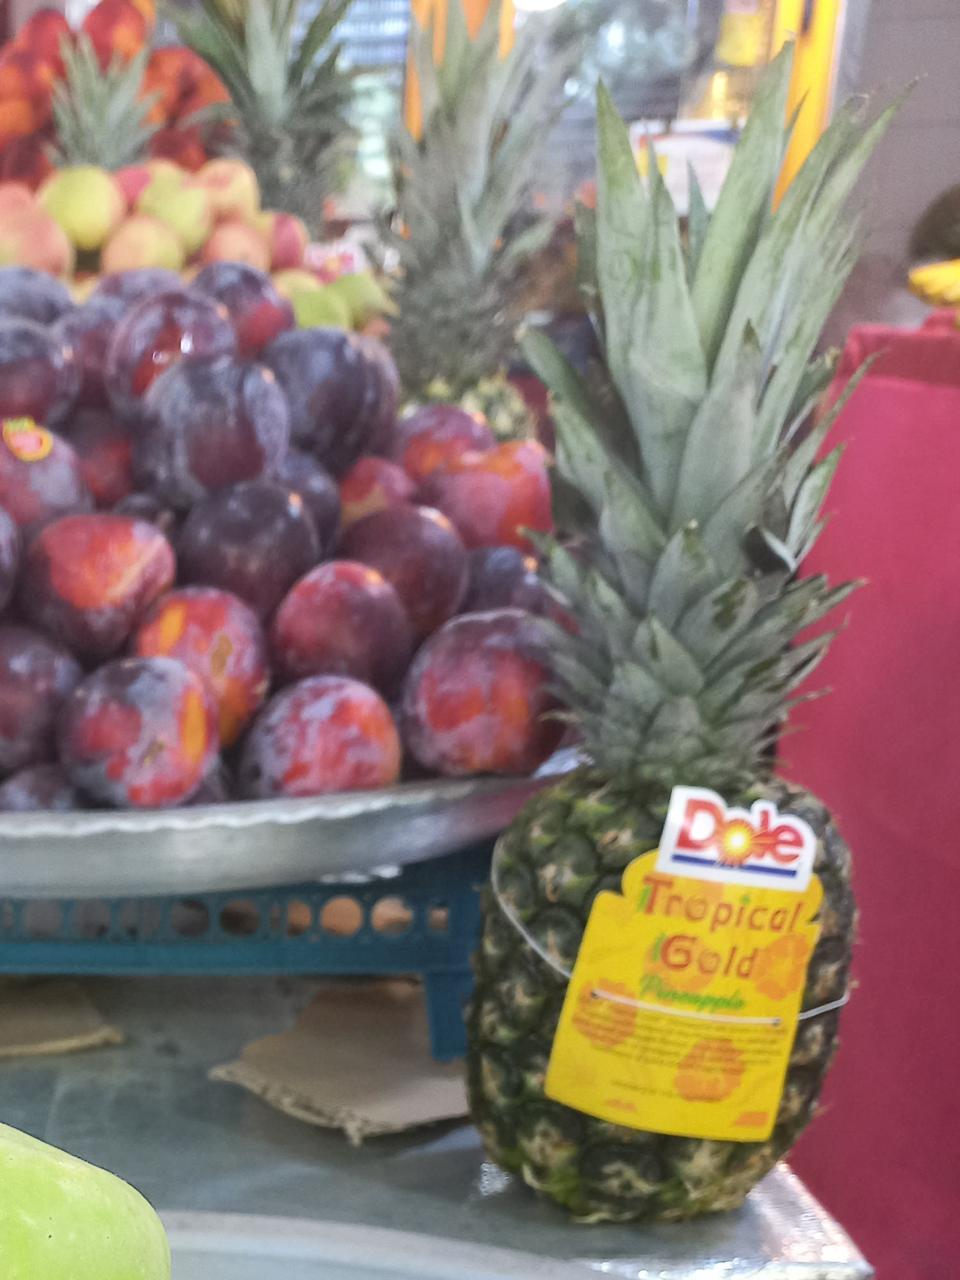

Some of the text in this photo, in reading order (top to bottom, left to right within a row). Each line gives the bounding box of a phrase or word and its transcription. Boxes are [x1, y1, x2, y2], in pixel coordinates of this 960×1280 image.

[676, 798, 804, 866] Dole
[639, 876, 804, 933] Tropical
[656, 934, 759, 979] Gold
